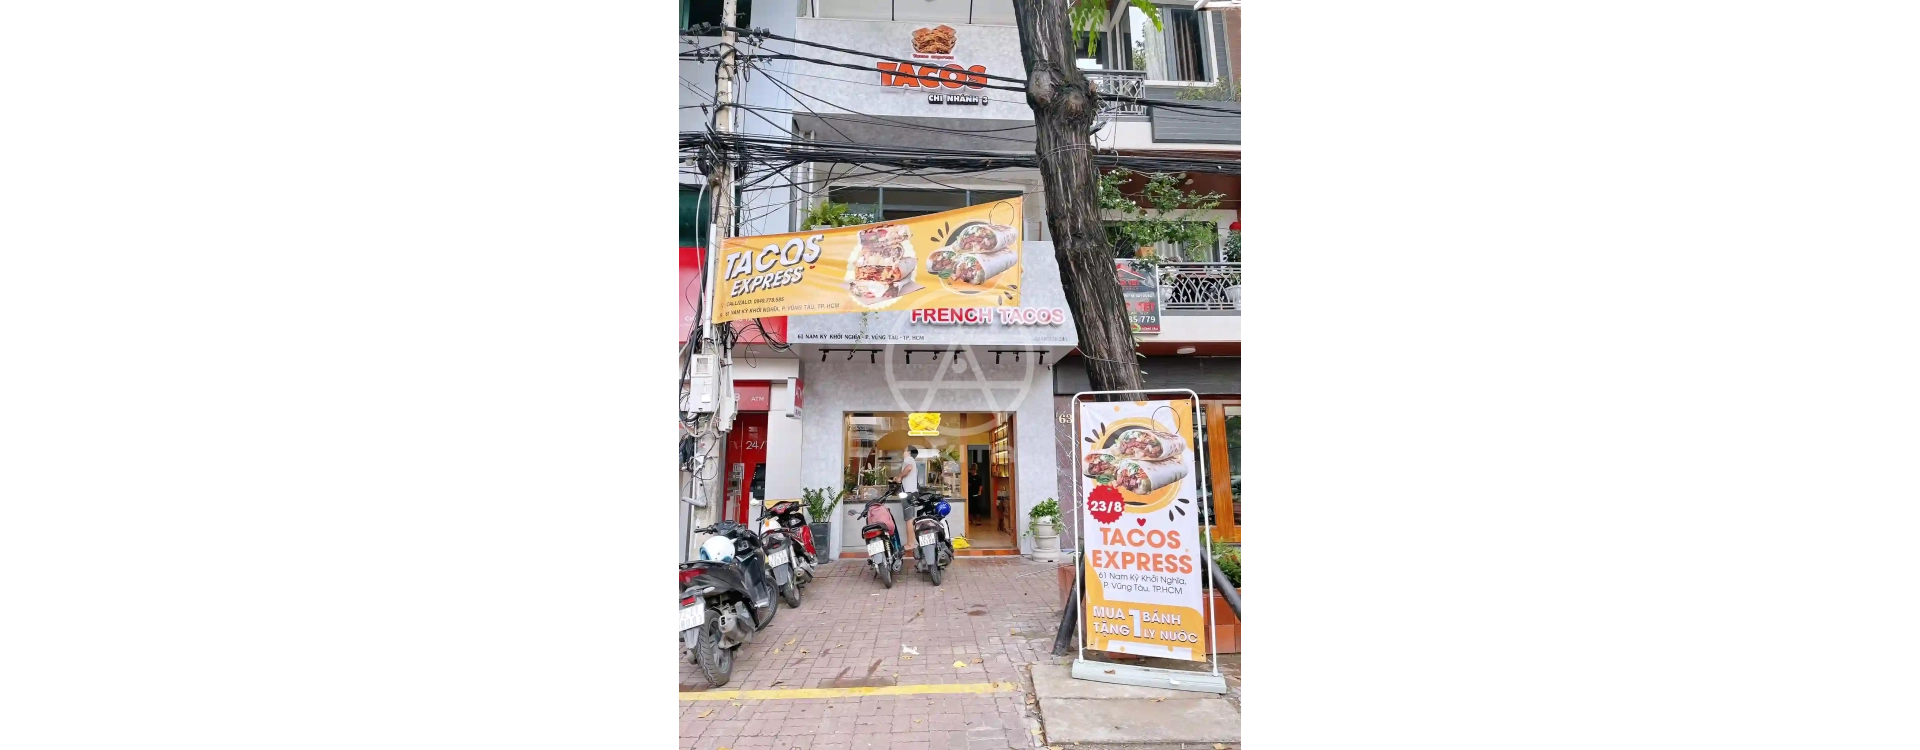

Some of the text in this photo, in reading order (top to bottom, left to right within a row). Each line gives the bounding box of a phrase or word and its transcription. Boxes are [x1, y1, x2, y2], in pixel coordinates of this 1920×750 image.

[876, 61, 988, 90] TACOS
[928, 93, 988, 106] CHI NHÁNH 3
[724, 234, 824, 280] TACOS
[730, 266, 804, 298] EXPRESS
[911, 307, 1065, 324] FRENCH TACOS
[1140, 315, 1155, 323] 779
[1059, 413, 1072, 424] 63
[1090, 500, 1122, 513] 23/8
[1099, 527, 1181, 549] TACOS
[1092, 549, 1193, 574] EXPRESS
[1098, 571, 1107, 579] 61
[1109, 572, 1128, 581] Nam
[1130, 573, 1139, 583] Kỳ
[1141, 573, 1159, 583] Khởi
[1103, 581, 1109, 589] P.
[1111, 582, 1132, 592] Vũng
[1153, 585, 1183, 595] TP.HCM
[1093, 605, 1181, 638] MUA 1 BÁNH
[1093, 620, 1130, 637] TẶNG
[1143, 628, 1156, 639] LY
